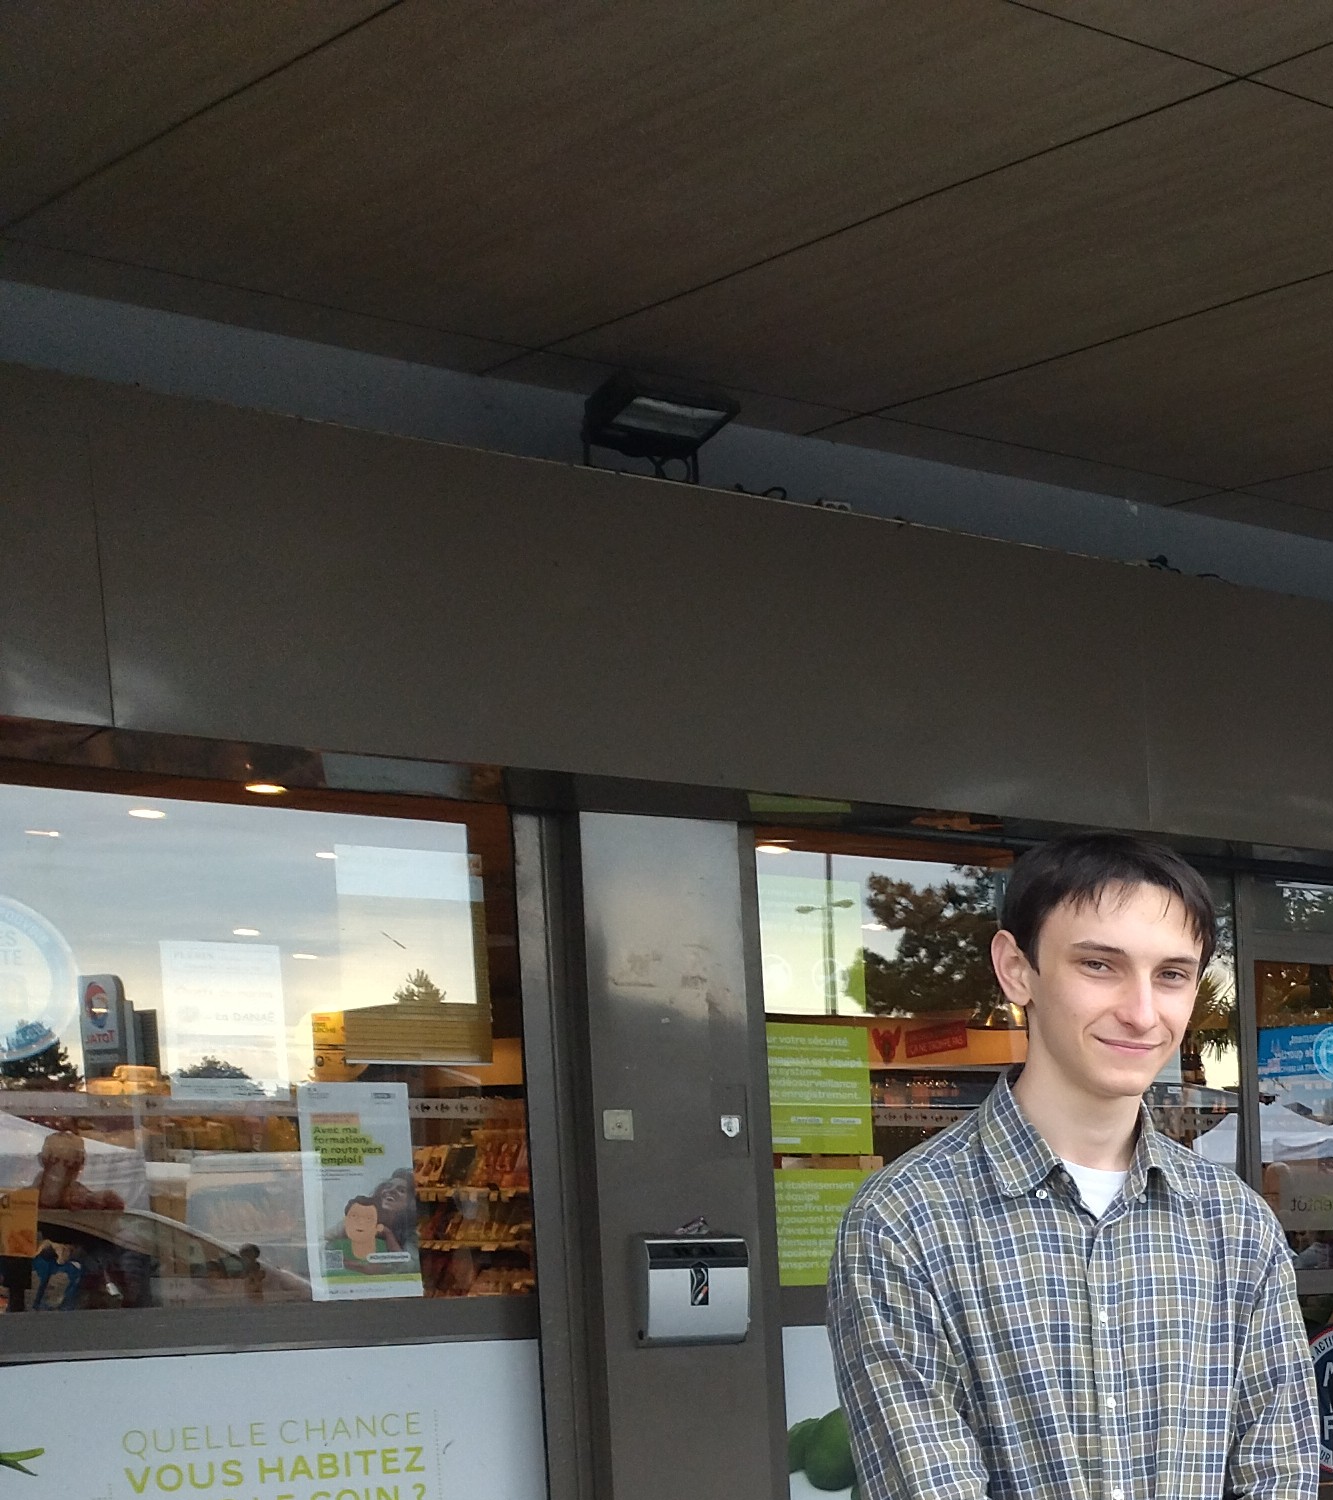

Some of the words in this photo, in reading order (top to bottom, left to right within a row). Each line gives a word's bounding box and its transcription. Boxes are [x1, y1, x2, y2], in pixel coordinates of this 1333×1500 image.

[779, 1037, 807, 1045] votre
[808, 1036, 849, 1046] sécurité
[313, 1126, 339, 1134] Avec
[313, 1135, 369, 1145] formation,
[330, 1146, 359, 1154] route
[785, 1181, 854, 1190] établissement
[122, 1422, 268, 1460] QUELLE
[279, 1412, 422, 1444] CHANCE
[124, 1459, 244, 1494] VOUS
[258, 1447, 426, 1484] HABITEZ
